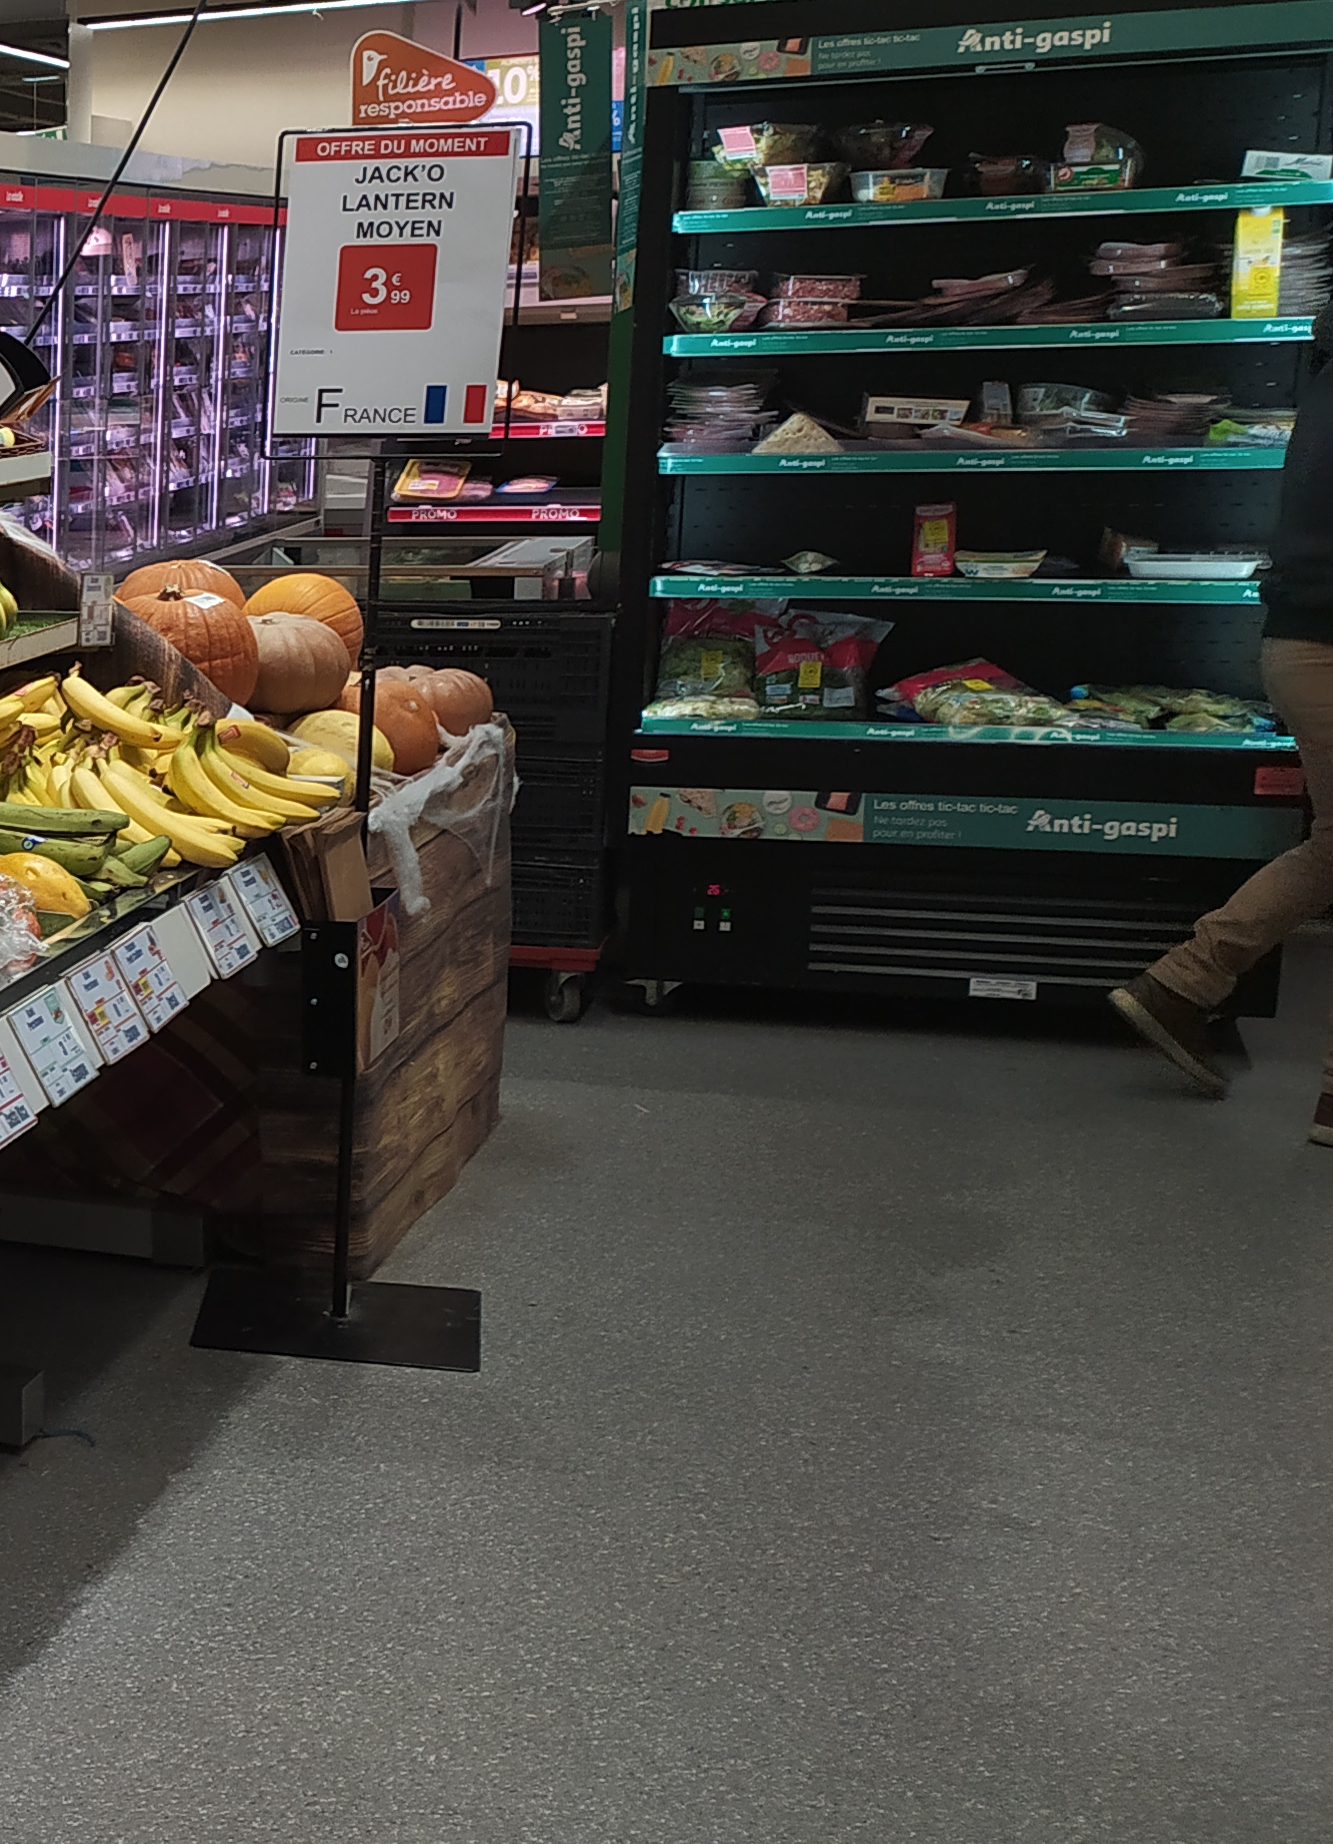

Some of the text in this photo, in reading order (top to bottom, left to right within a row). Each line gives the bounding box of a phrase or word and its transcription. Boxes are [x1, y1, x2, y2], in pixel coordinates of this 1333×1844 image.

[818, 36, 861, 48] Les offres
[957, 21, 1112, 54] Anti-gaspi
[377, 68, 456, 101] filière
[559, 26, 586, 150] Anti-gaspi
[358, 91, 486, 119] responsable
[316, 137, 488, 157] OFFRE DU MOMENT
[355, 164, 445, 185] JACK'O
[341, 192, 455, 213] LANTERN
[1176, 192, 1228, 205] Anti-gaspi
[986, 200, 1035, 213] Anti-gaspi
[805, 209, 852, 222] Anti-gaspi
[355, 219, 443, 239] MOYEN
[362, 268, 410, 304] 3 99
[885, 335, 934, 346] Anti-gaspi
[1069, 328, 1120, 341] Anti-gaspi
[711, 338, 757, 349] Anti-gaspi
[316, 388, 416, 423] FRANCE
[779, 458, 826, 470] Anti-gaspi
[957, 456, 1006, 469] Anti-gaspi
[1142, 454, 1195, 468] Anti-gaspi
[411, 509, 457, 520] PROMO
[532, 508, 580, 520] PROMO
[874, 800, 1019, 815] Les offres tic-tac tic-tac
[1026, 810, 1179, 842] Anti-gaspi
